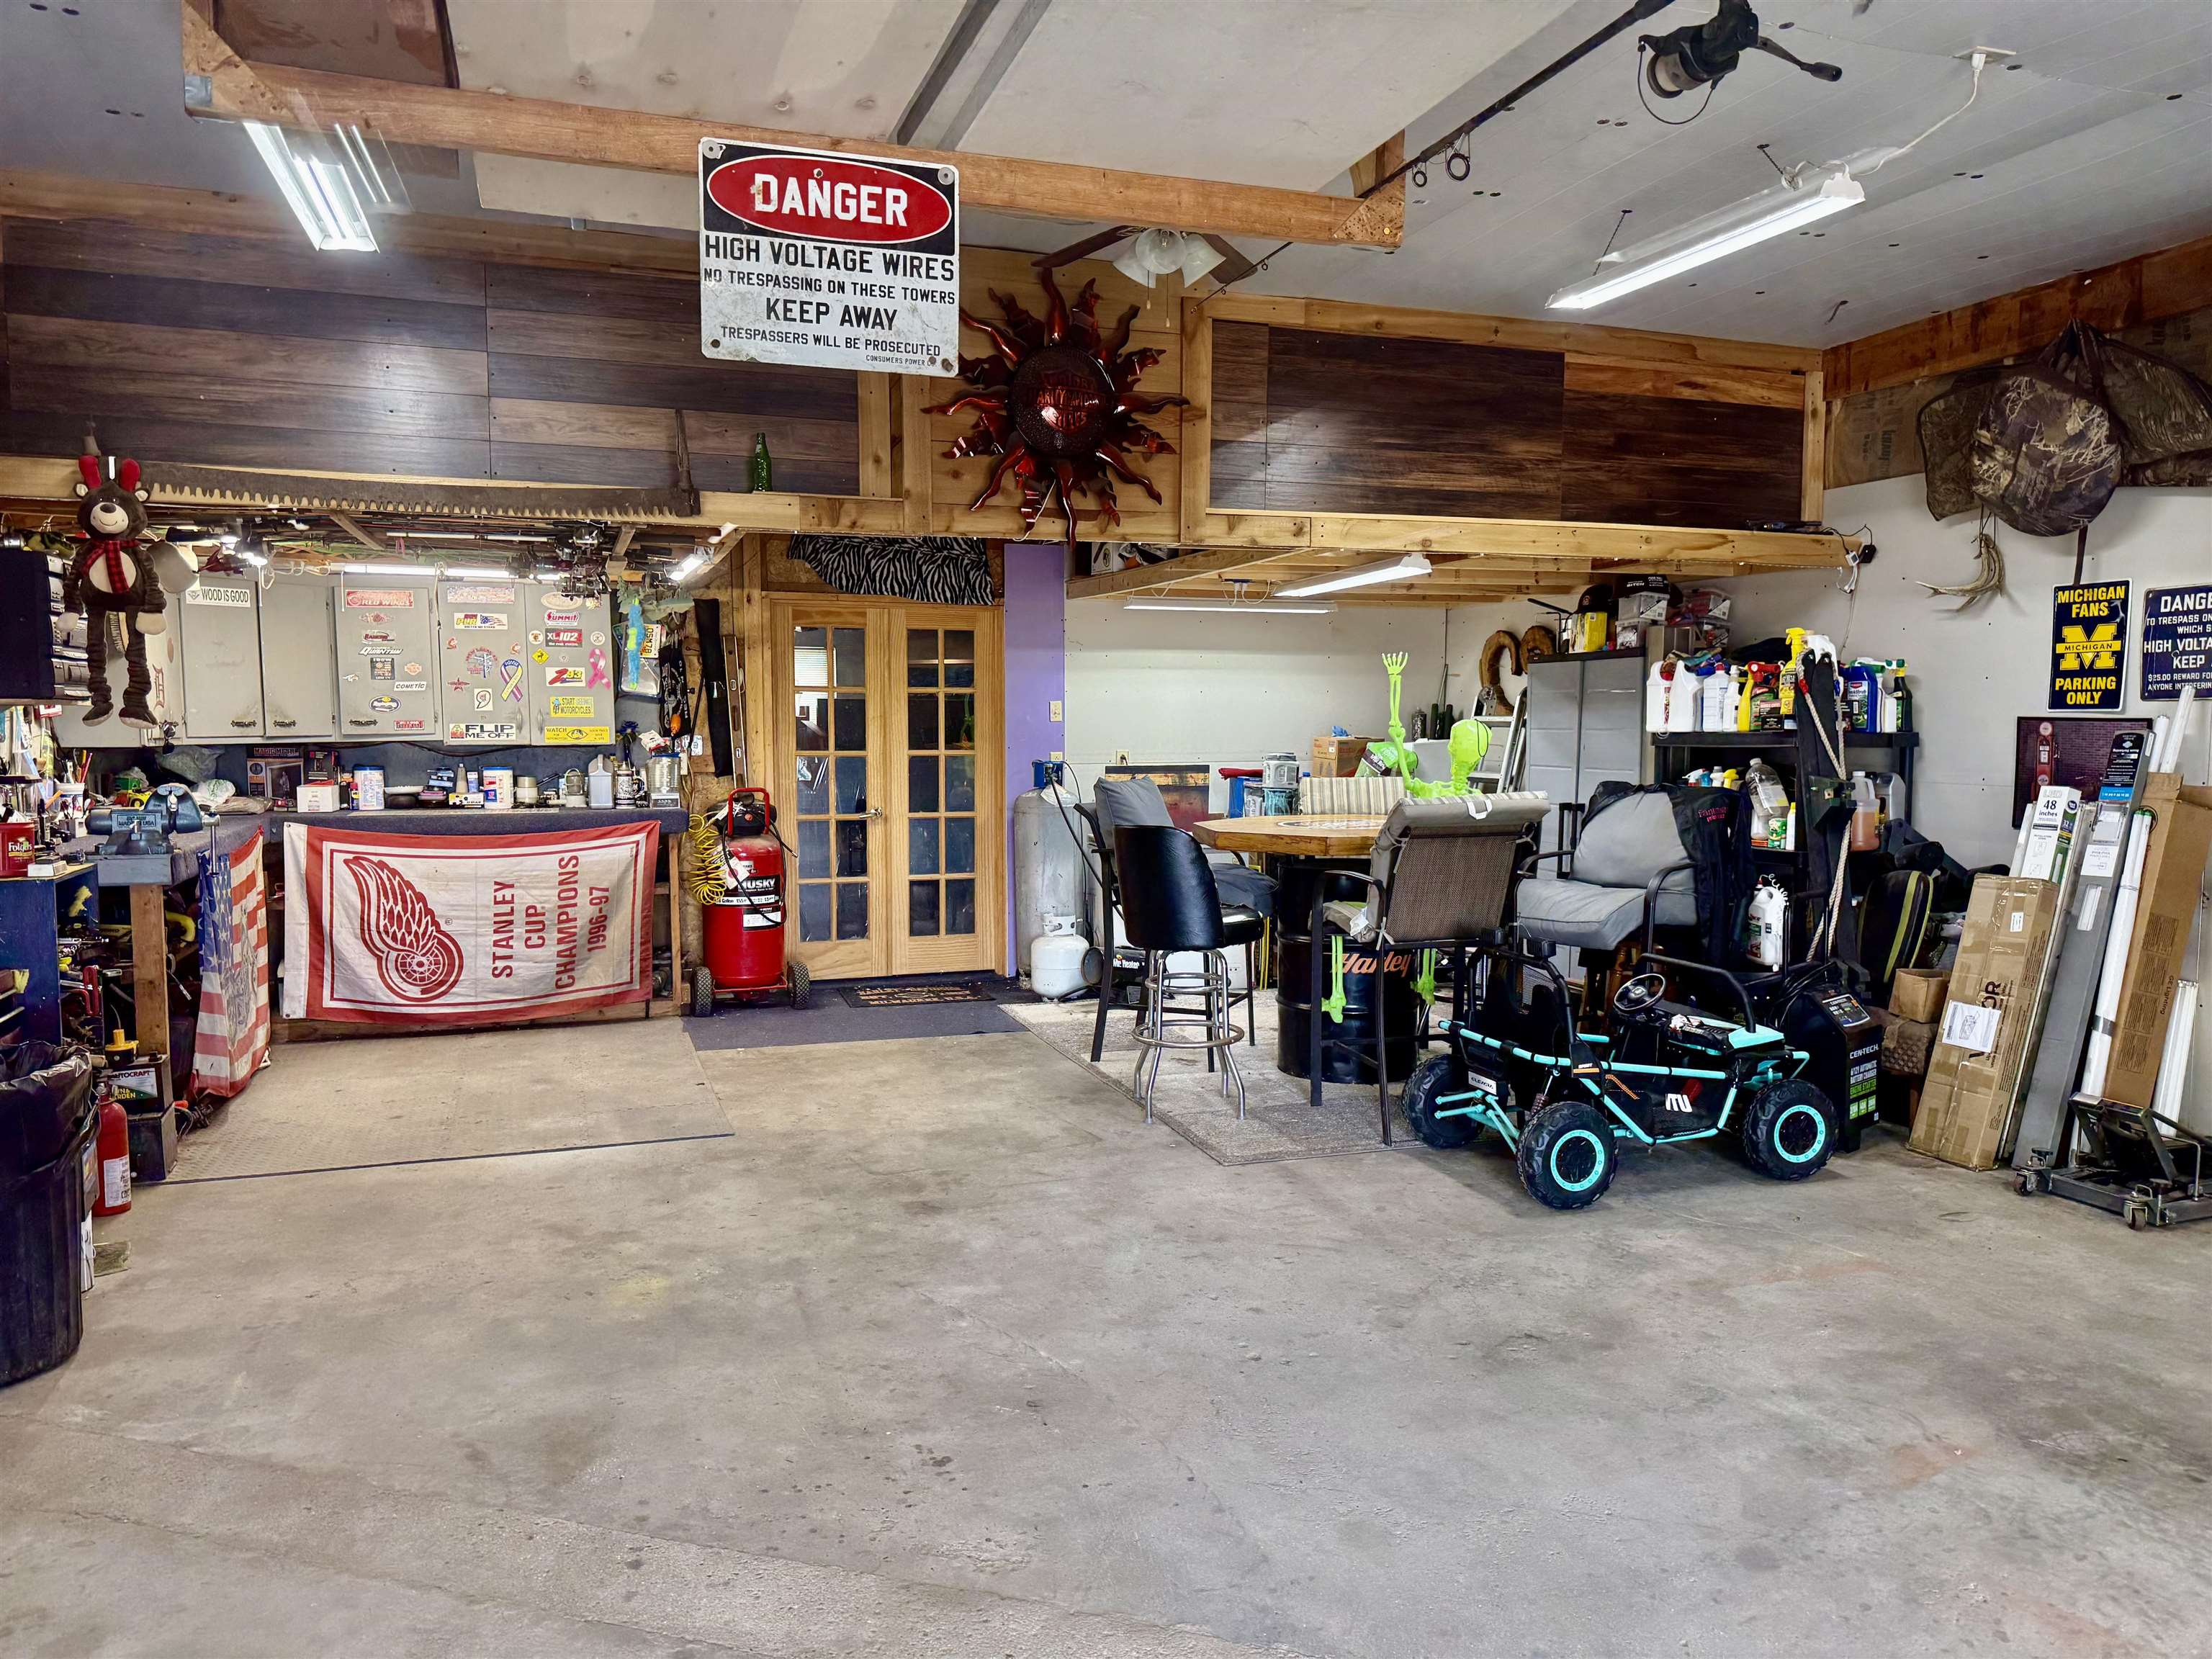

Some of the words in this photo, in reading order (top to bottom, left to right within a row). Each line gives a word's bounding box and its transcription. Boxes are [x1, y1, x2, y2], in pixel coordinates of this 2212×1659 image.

[755, 173, 907, 227] DANGER
[705, 235, 760, 263] HIGH
[769, 241, 873, 274] VOLTAGE
[882, 253, 955, 282] WIRES
[703, 267, 722, 283] NO
[728, 270, 822, 292] TRESPASSING
[828, 280, 845, 294] ON
[851, 282, 896, 299] THESE
[902, 287, 956, 305] TOWERS
[766, 297, 830, 324] KEEP
[840, 305, 898, 331] AWAY
[721, 325, 809, 345] TRESPASSERS
[812, 334, 841, 348] WILL
[845, 338, 860, 349] BE
[865, 338, 941, 356] PROSECUTED
[866, 355, 903, 364] CONSUMERS
[202, 588, 222, 601] WOOD
[223, 590, 229, 601] IS
[230, 590, 248, 603] GOOD
[2057, 586, 2126, 603] MICHIGAN
[2072, 602, 2109, 619] FANS
[2159, 614, 2199, 624] TRESPASS
[2177, 625, 2203, 634] WHICH
[2064, 643, 2113, 652] MICHIGAN
[2144, 639, 2172, 652] HIGH
[2173, 655, 2205, 669] KEEP
[2055, 677, 2116, 691] PARKING
[2066, 692, 2101, 705] ONLY
[2044, 800, 2056, 810] 48
[525, 904, 547, 950] CUP
[554, 855, 580, 990] CHAMPIONS
[587, 886, 610, 953] 1996-97
[491, 881, 516, 979] STANLEY
[1342, 951, 1411, 977] Haley
